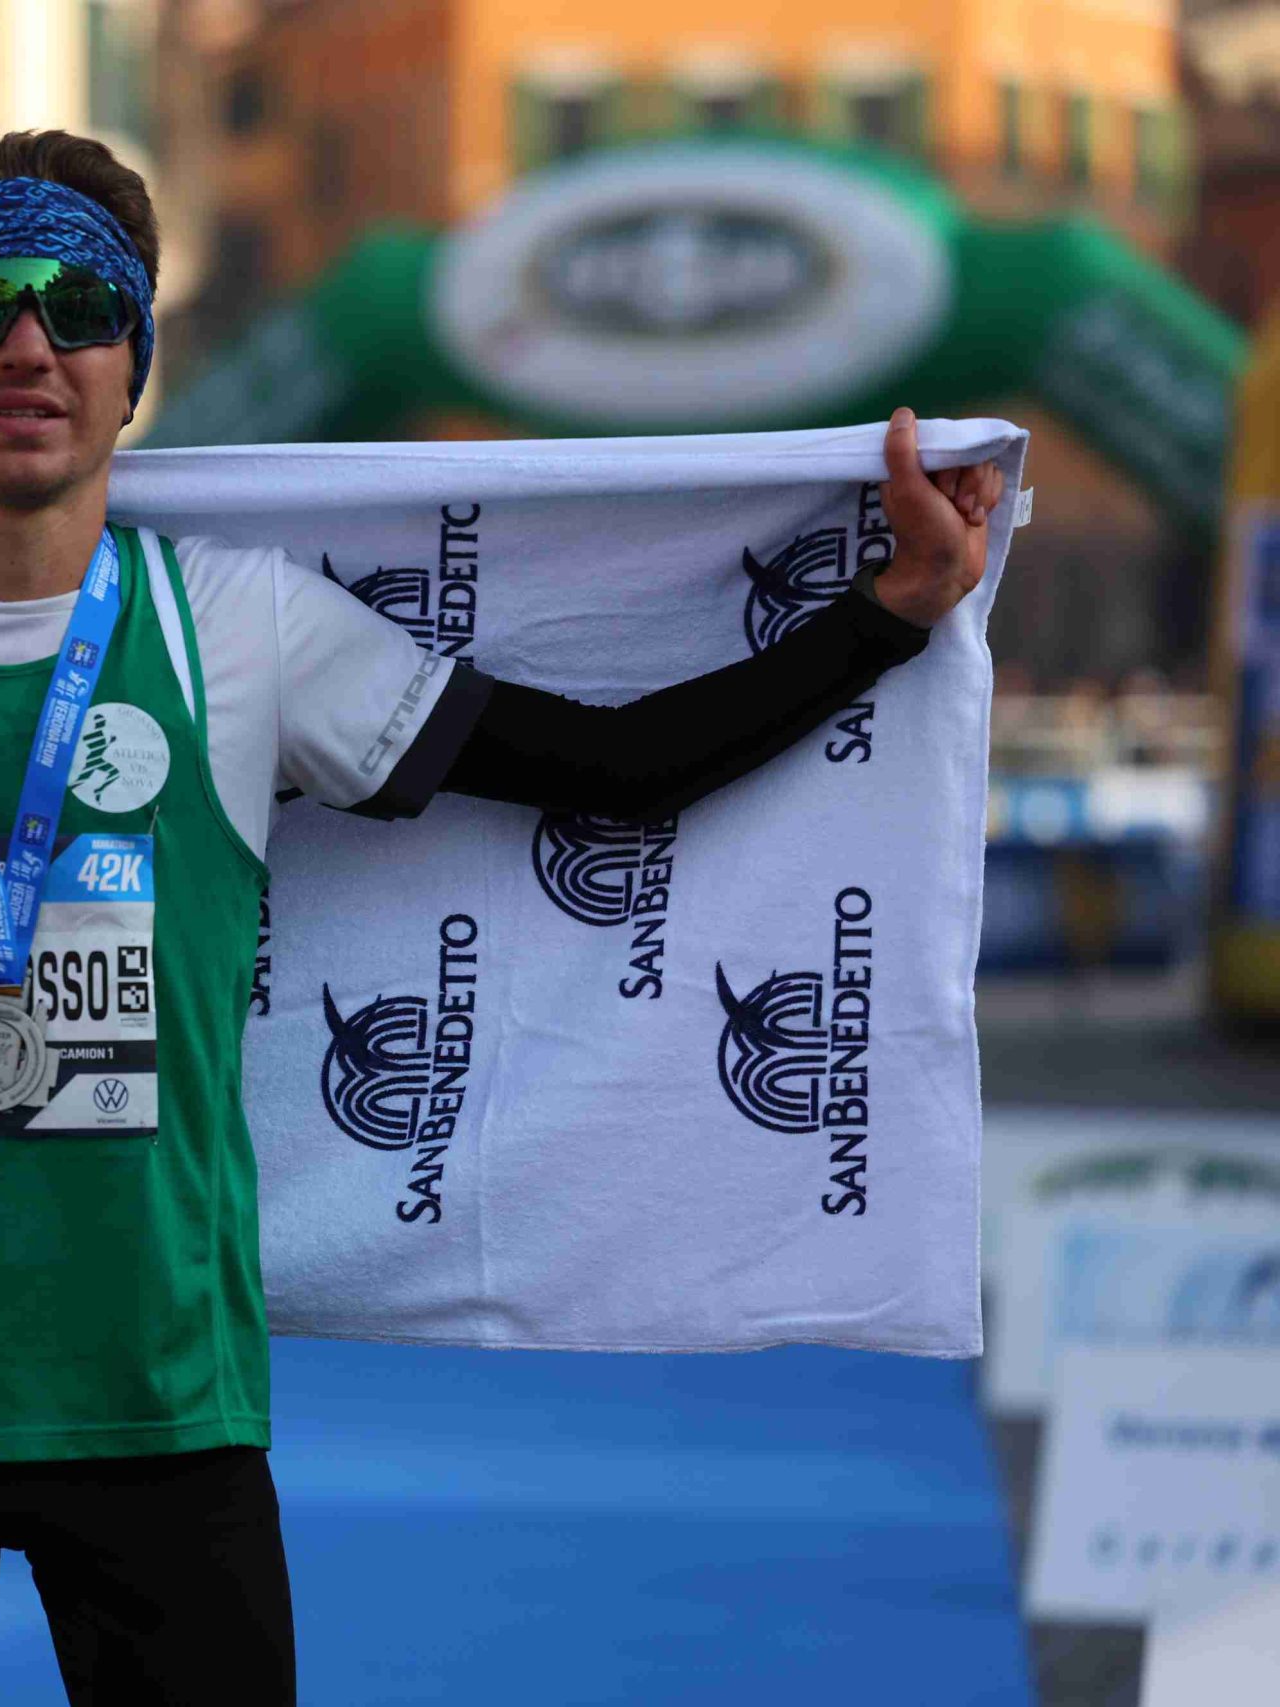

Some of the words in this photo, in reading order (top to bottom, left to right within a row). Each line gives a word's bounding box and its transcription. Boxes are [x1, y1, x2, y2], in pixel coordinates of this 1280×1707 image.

[825, 702, 875, 764] SA
[77, 853, 144, 892] 42K
[618, 918, 666, 1000] SAN
[416, 914, 478, 1143] BENEDETTO
[822, 887, 872, 1128] BENEDETTO
[107, 1047, 114, 1059] 1
[396, 1145, 449, 1224] SAN
[821, 1133, 869, 1216] SAN
